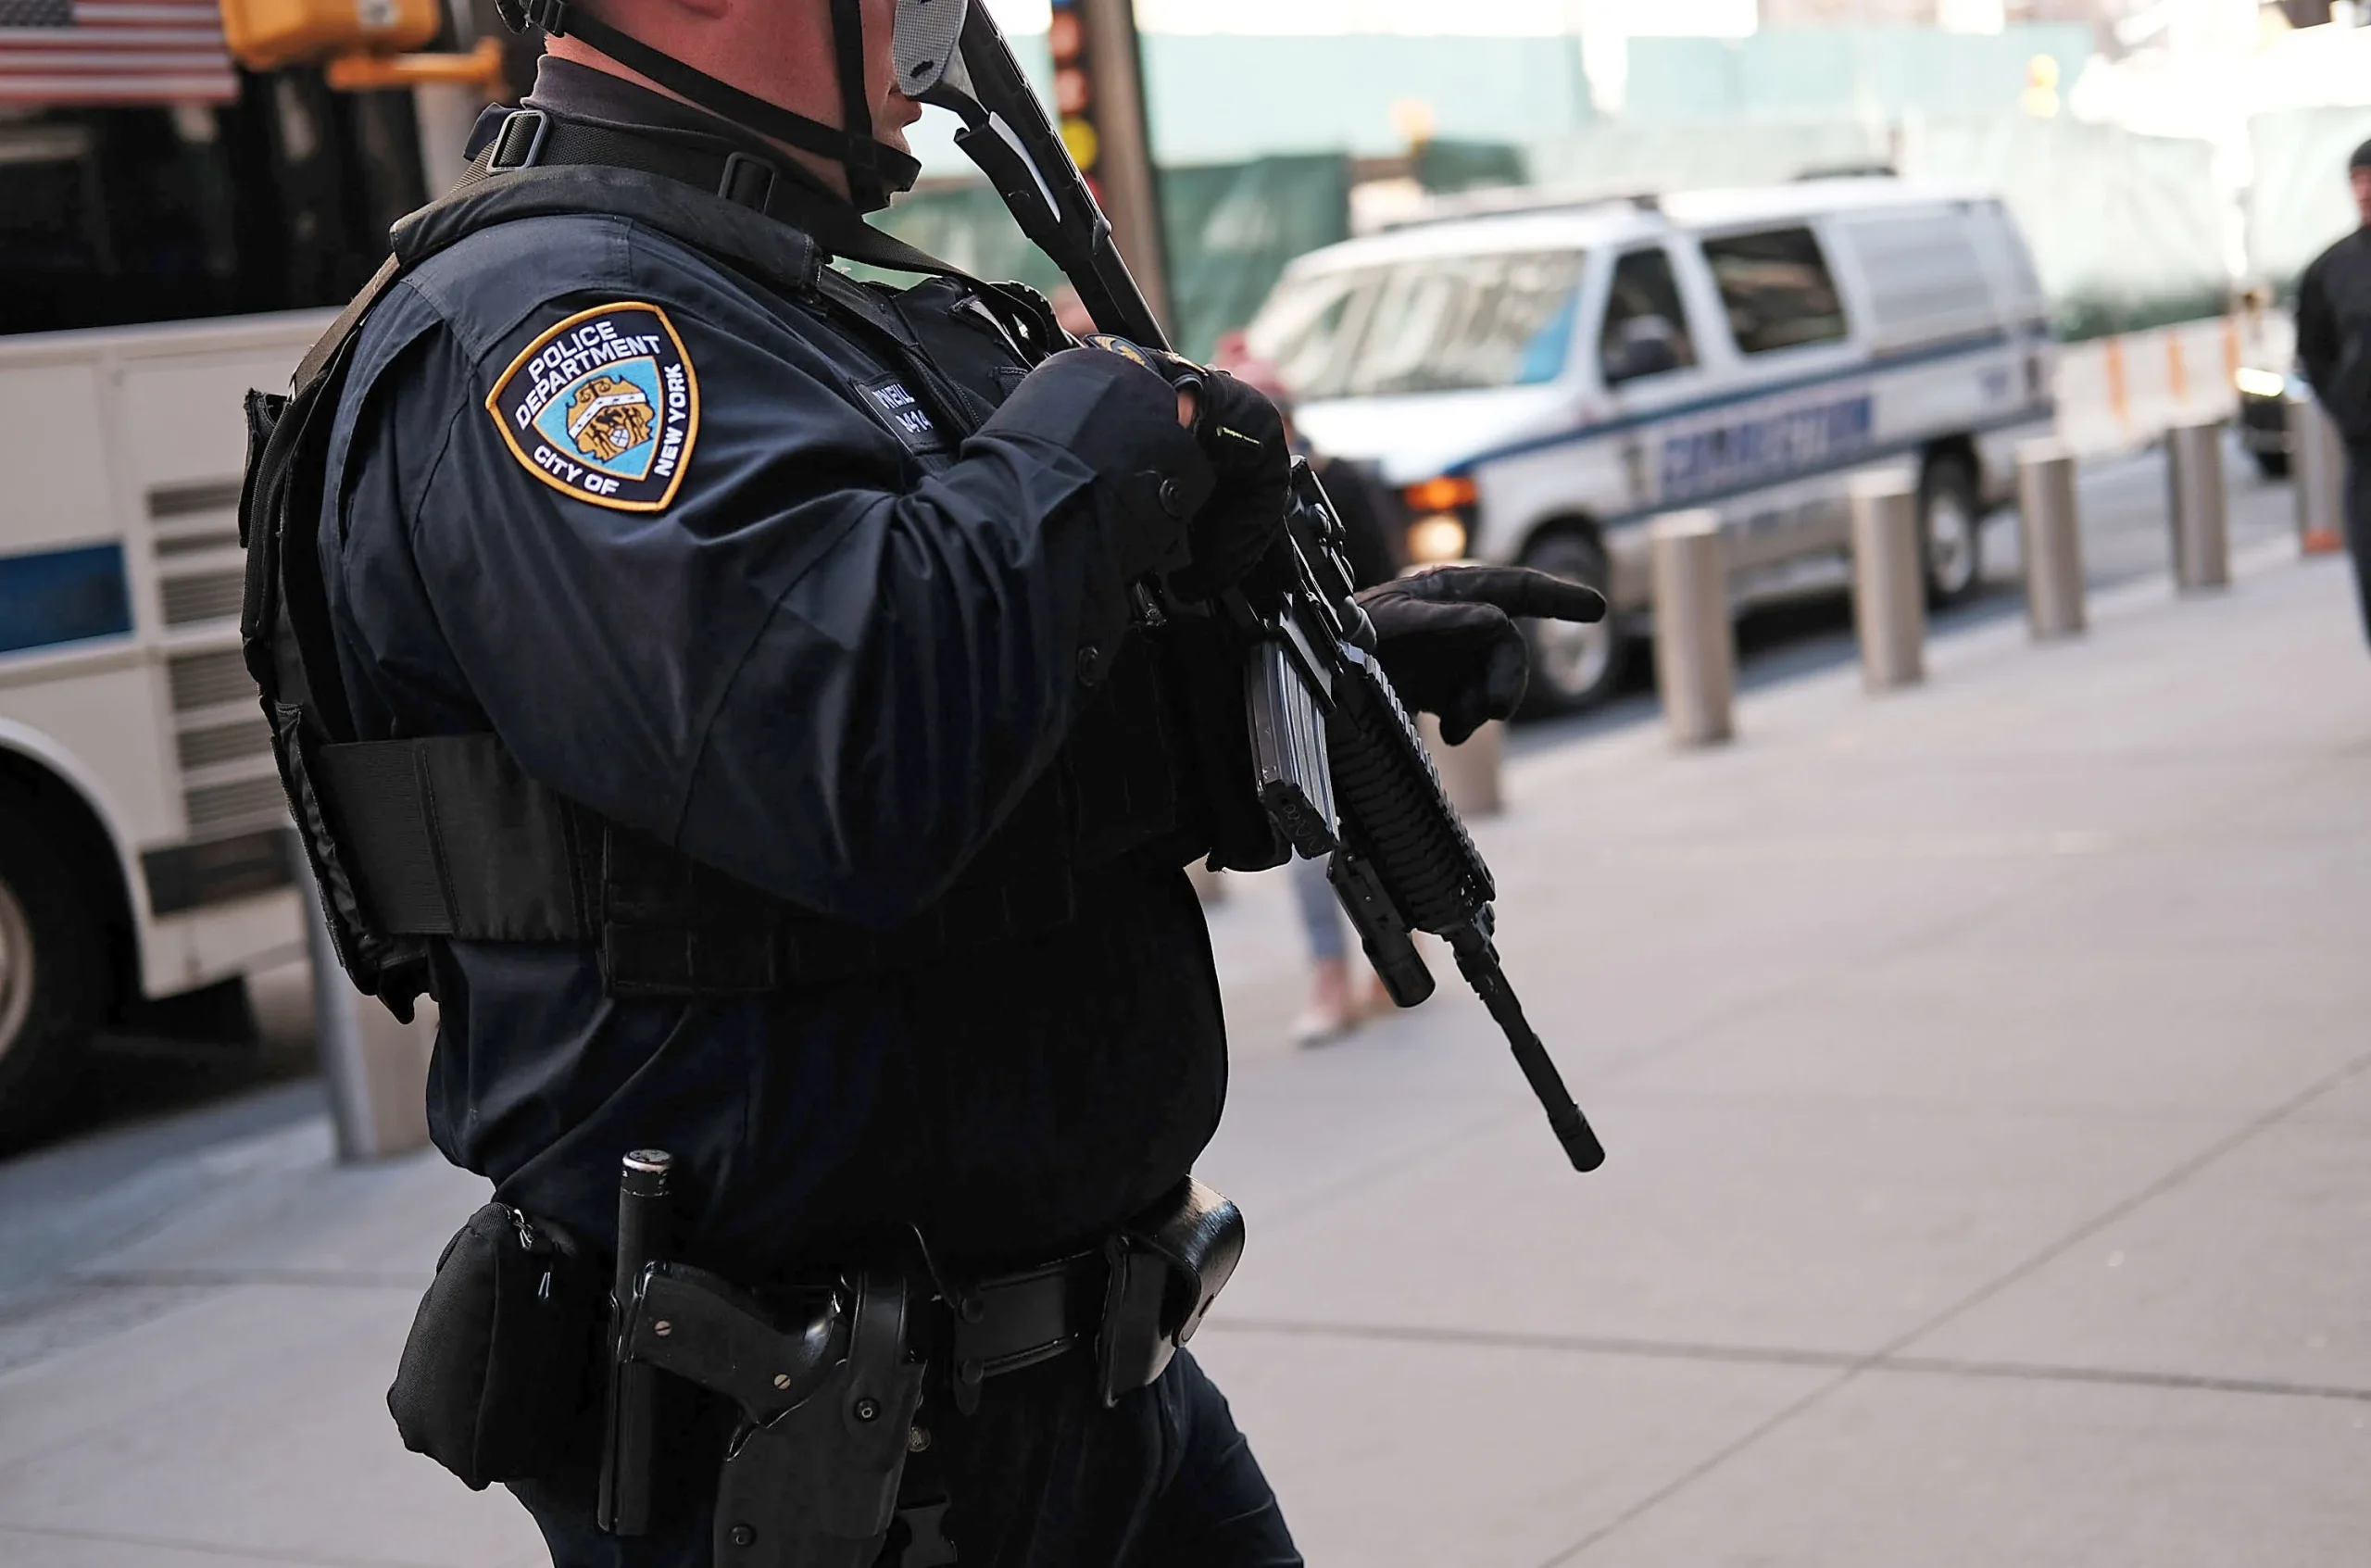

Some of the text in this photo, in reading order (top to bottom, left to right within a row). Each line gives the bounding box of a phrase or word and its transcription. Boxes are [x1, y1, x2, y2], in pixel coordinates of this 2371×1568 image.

[515, 335, 660, 430] DEPARTMENT
[528, 320, 618, 383] POLICE
[654, 363, 687, 477] NEW YORK
[533, 445, 620, 495] CITY OF
